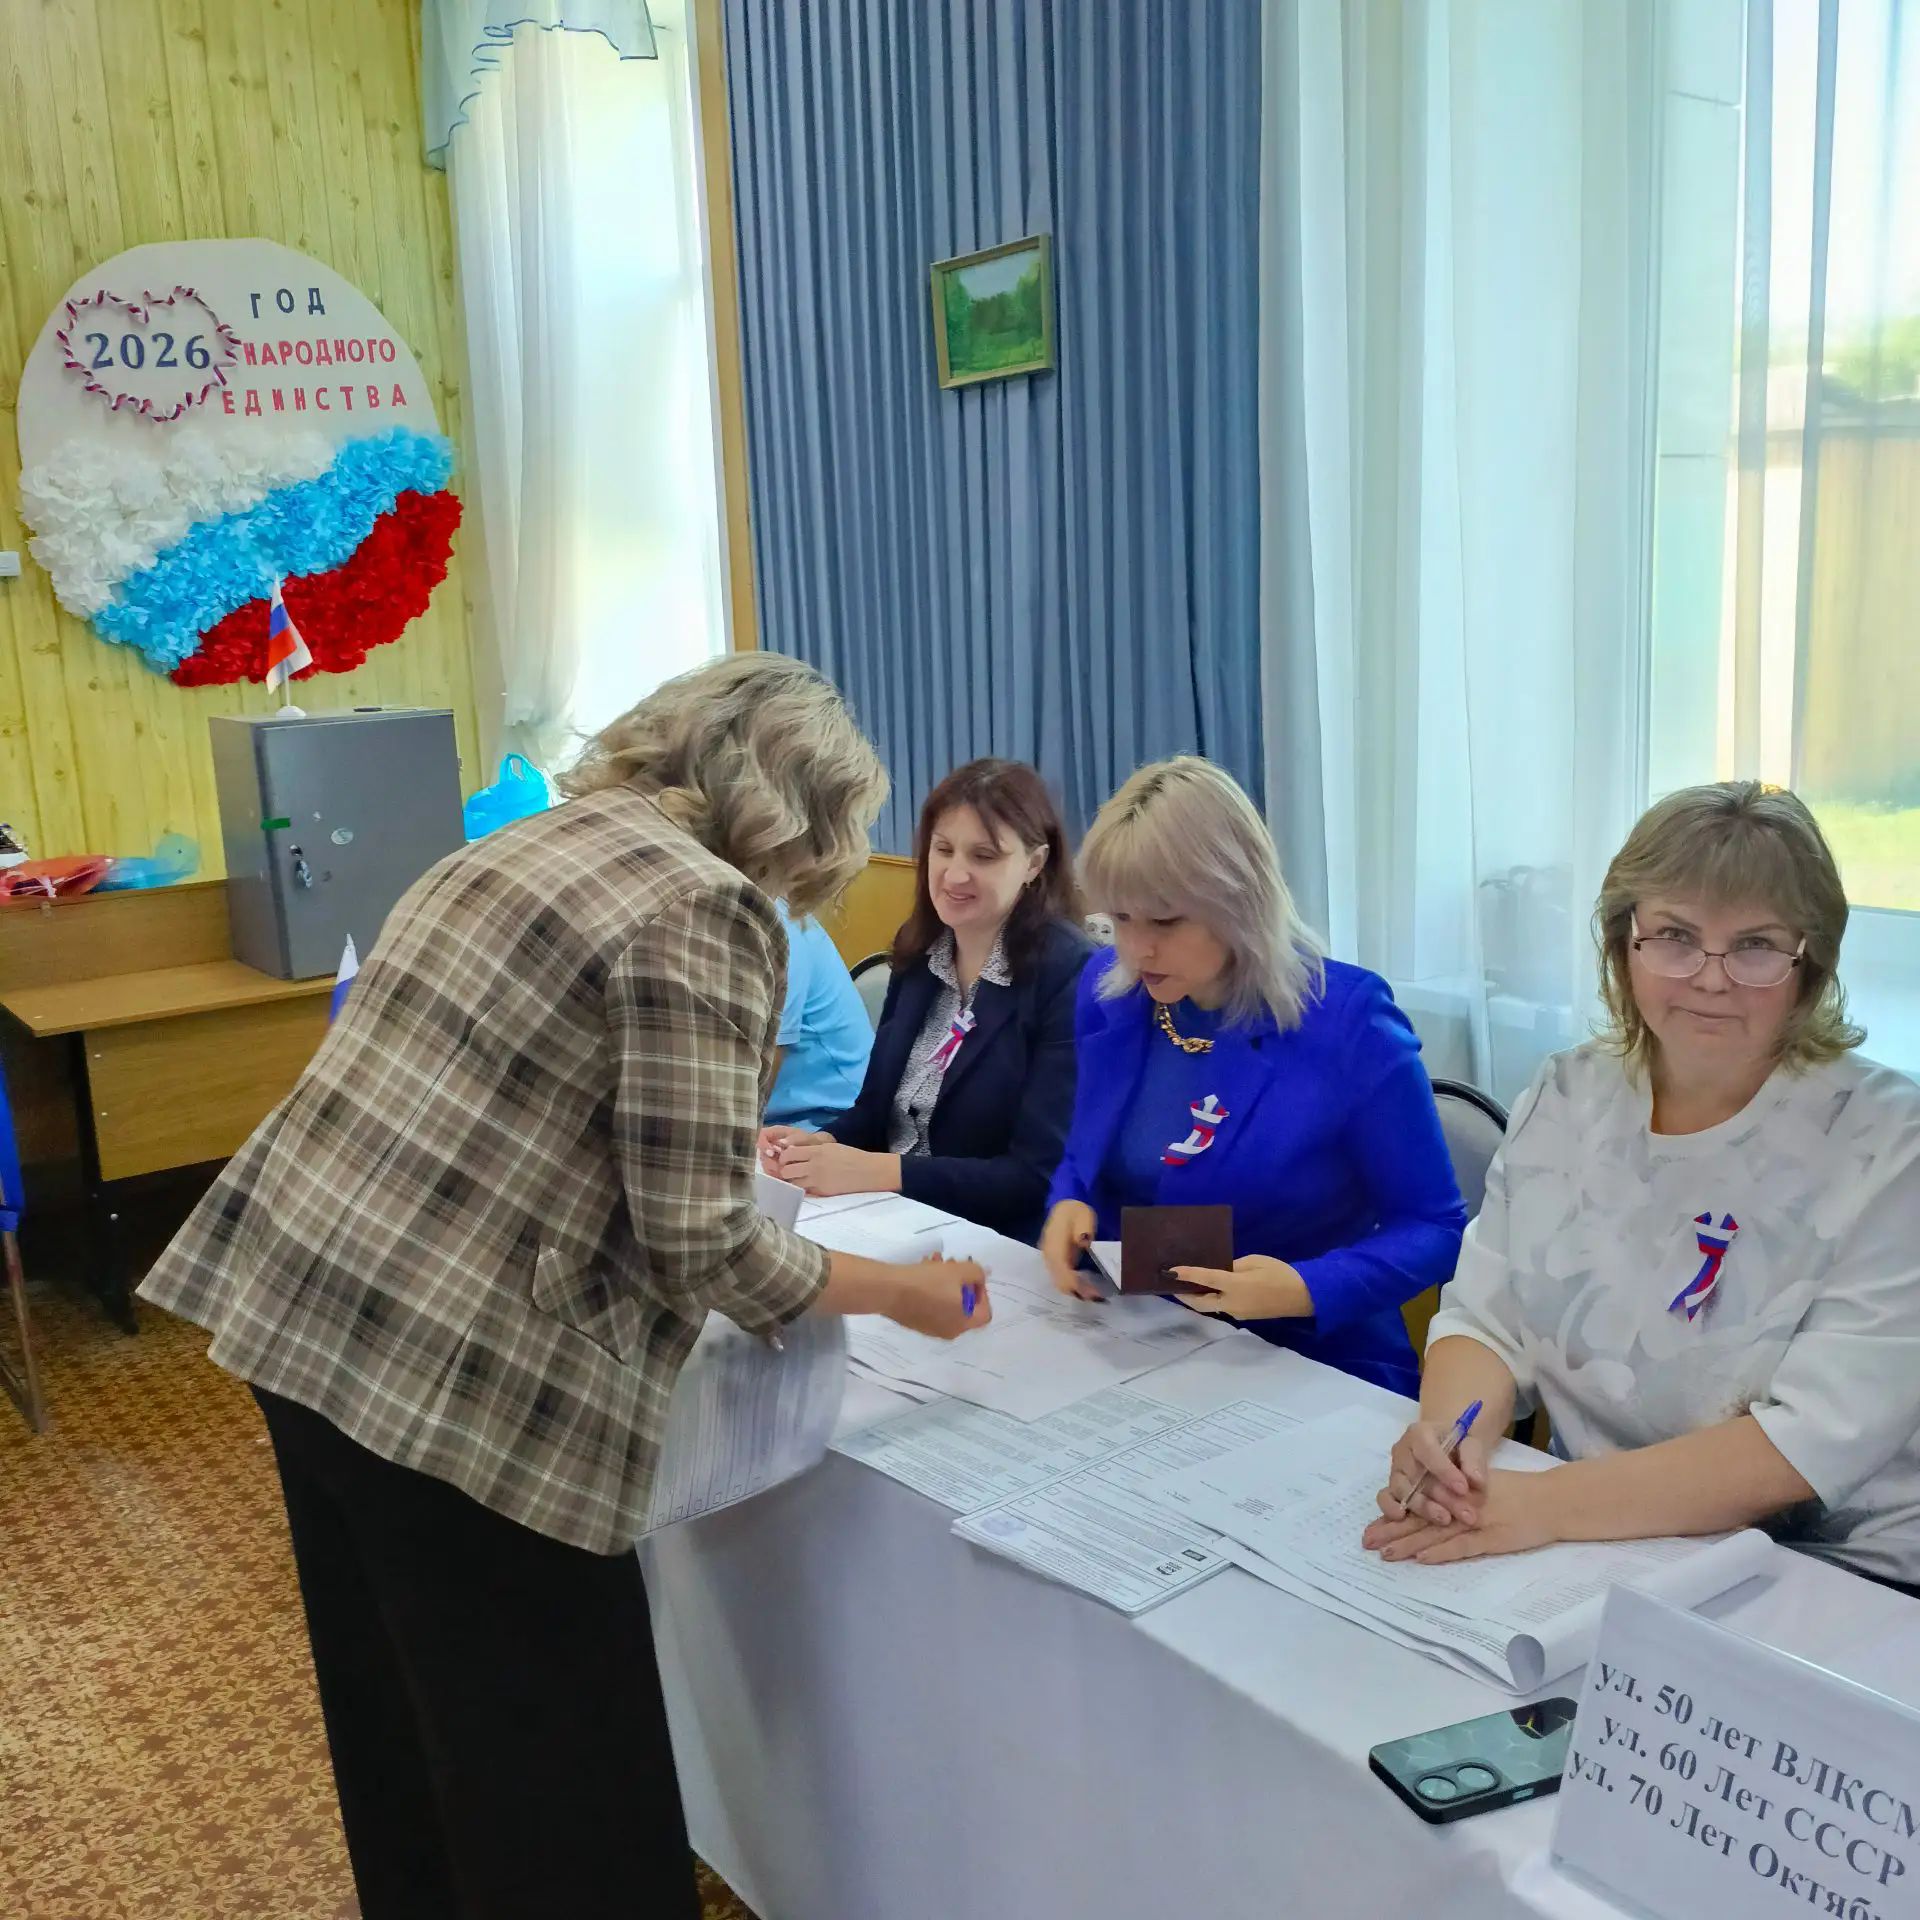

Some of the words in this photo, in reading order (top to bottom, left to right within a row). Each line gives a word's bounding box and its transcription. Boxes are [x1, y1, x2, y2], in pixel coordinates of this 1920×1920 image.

[250, 287, 325, 319] ГОД
[85, 332, 211, 370] 2026
[243, 338, 396, 367] НАРОДНОГО
[222, 383, 407, 416] ЕДИНСТВА
[1595, 1662, 1643, 1703] ул.
[1654, 1684, 1693, 1724] 50
[1700, 1716, 1763, 1760] лет
[1598, 1715, 1647, 1758] ул.
[1659, 1742, 1697, 1781] 60
[1704, 1766, 1775, 1821] Лет
[1784, 1807, 1906, 1887] СССР
[1568, 1751, 1614, 1793] ул.
[1628, 1773, 1663, 1815] 70
[1670, 1801, 1739, 1858] Лет
[1749, 1843, 1881, 1920] Октяб
